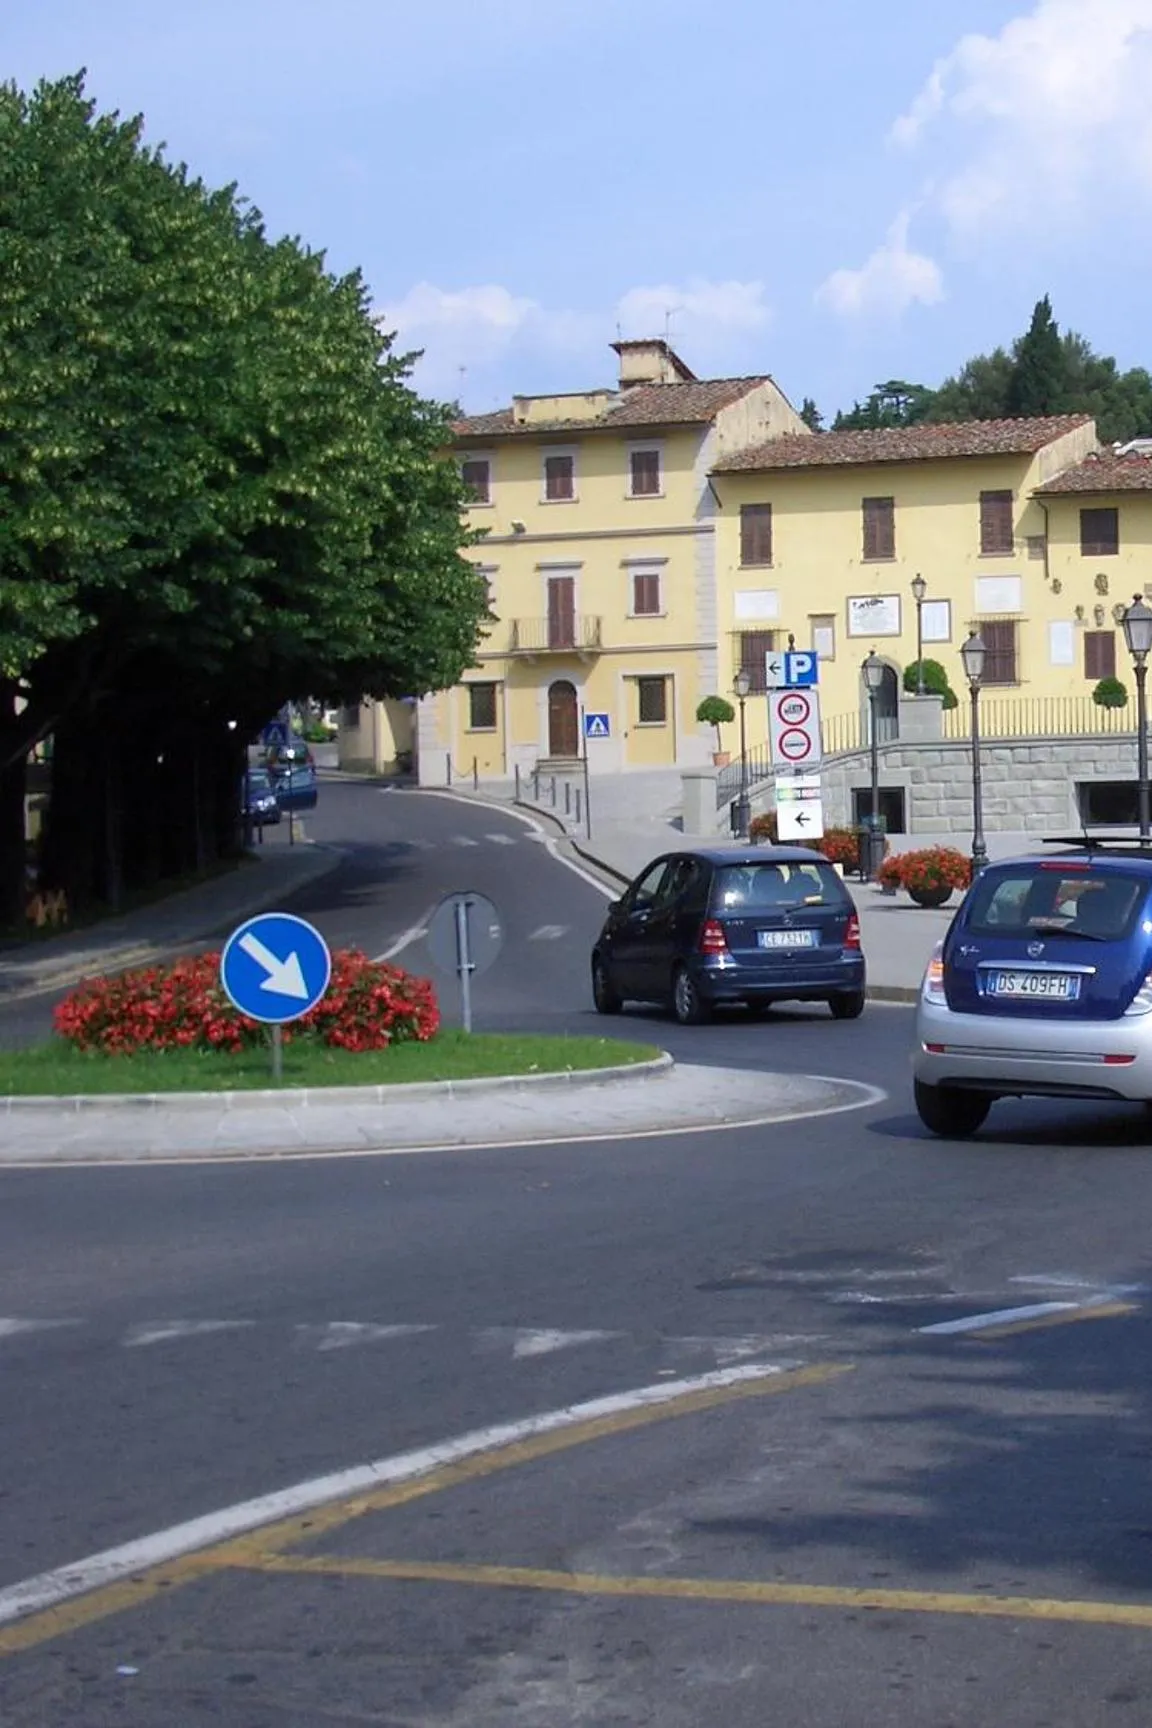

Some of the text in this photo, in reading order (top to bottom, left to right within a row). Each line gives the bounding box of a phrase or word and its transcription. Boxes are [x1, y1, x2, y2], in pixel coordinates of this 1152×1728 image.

[789, 653, 812, 683] P
[998, 974, 1068, 995] DS 409FH
